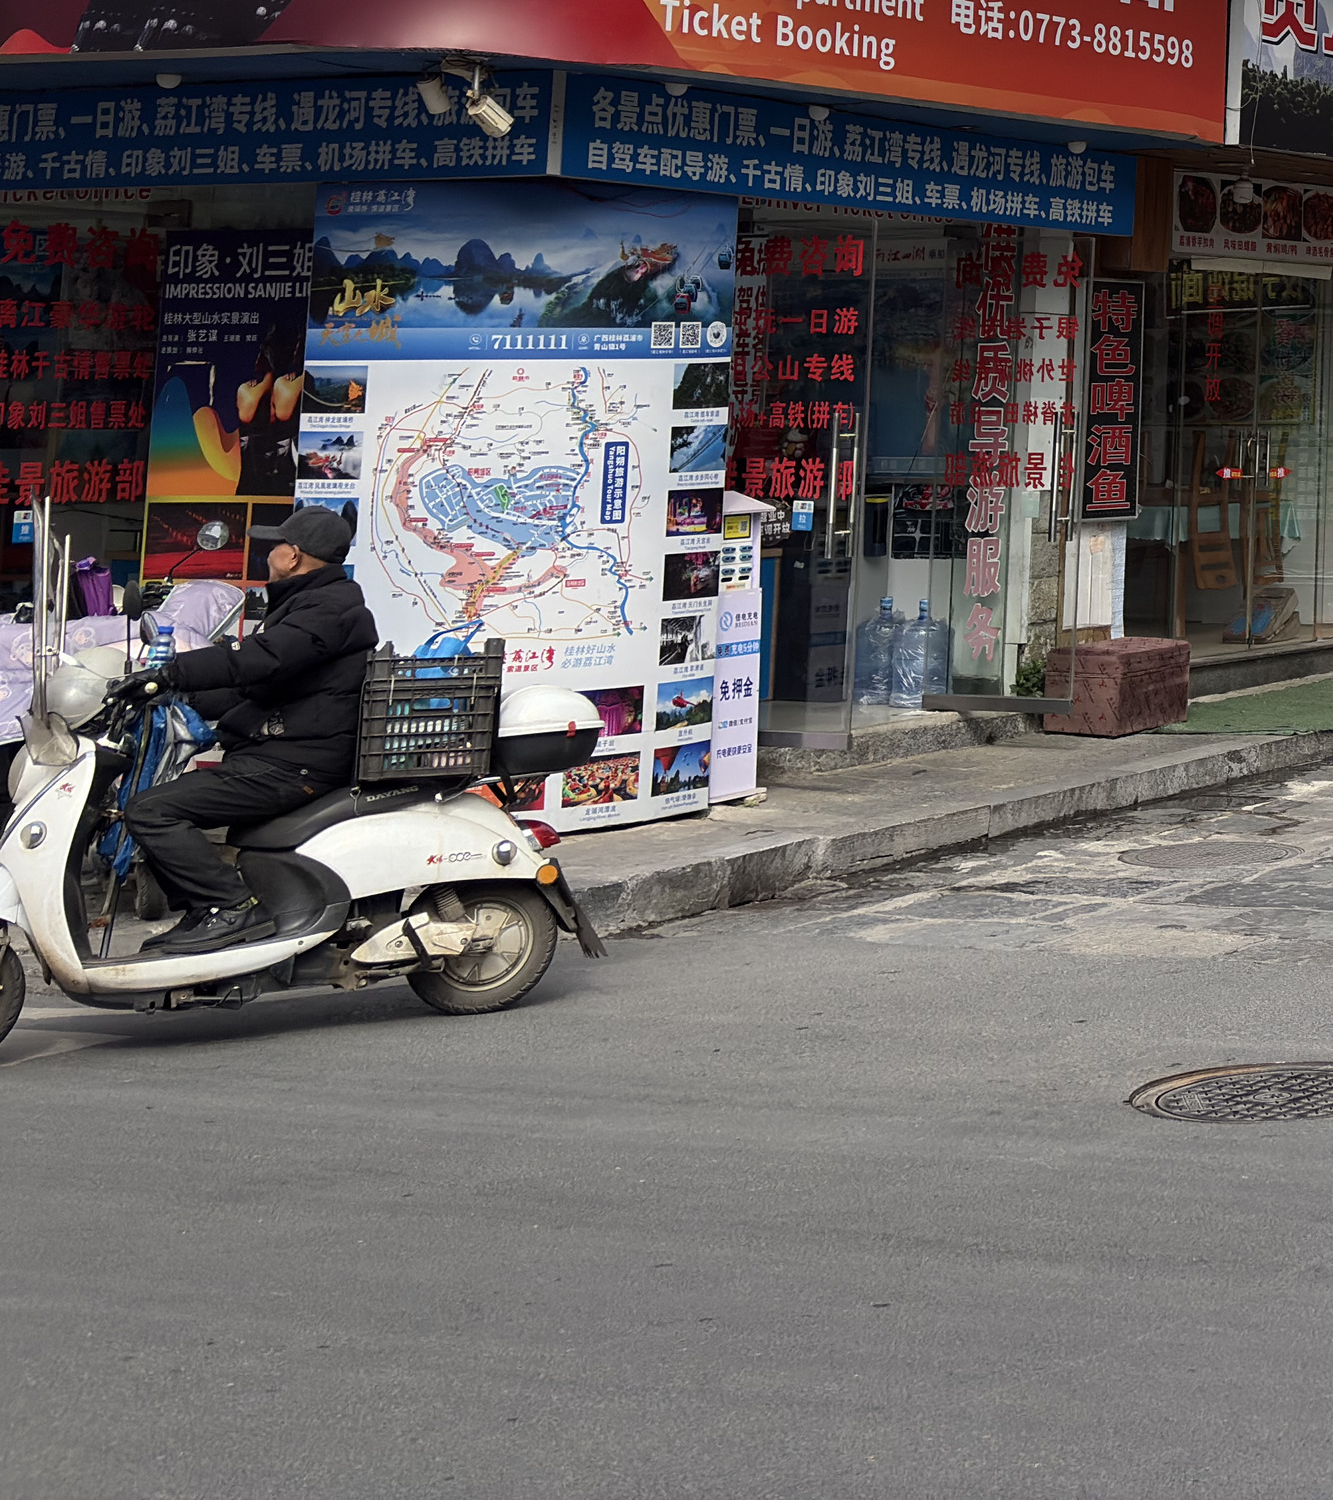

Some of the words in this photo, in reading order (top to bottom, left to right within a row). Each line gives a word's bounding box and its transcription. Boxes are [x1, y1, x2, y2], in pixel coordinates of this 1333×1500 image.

[661, 0, 761, 43] Ticket
[777, 18, 896, 70] Booking
[165, 283, 245, 299] IMPRESSION
[248, 282, 292, 300] SANJIE
[491, 334, 568, 350] 7111111
[1087, 290, 1138, 512] 特色啤酒鱼
[720, 677, 754, 702] 免押金
[366, 786, 419, 802] DAYANG
